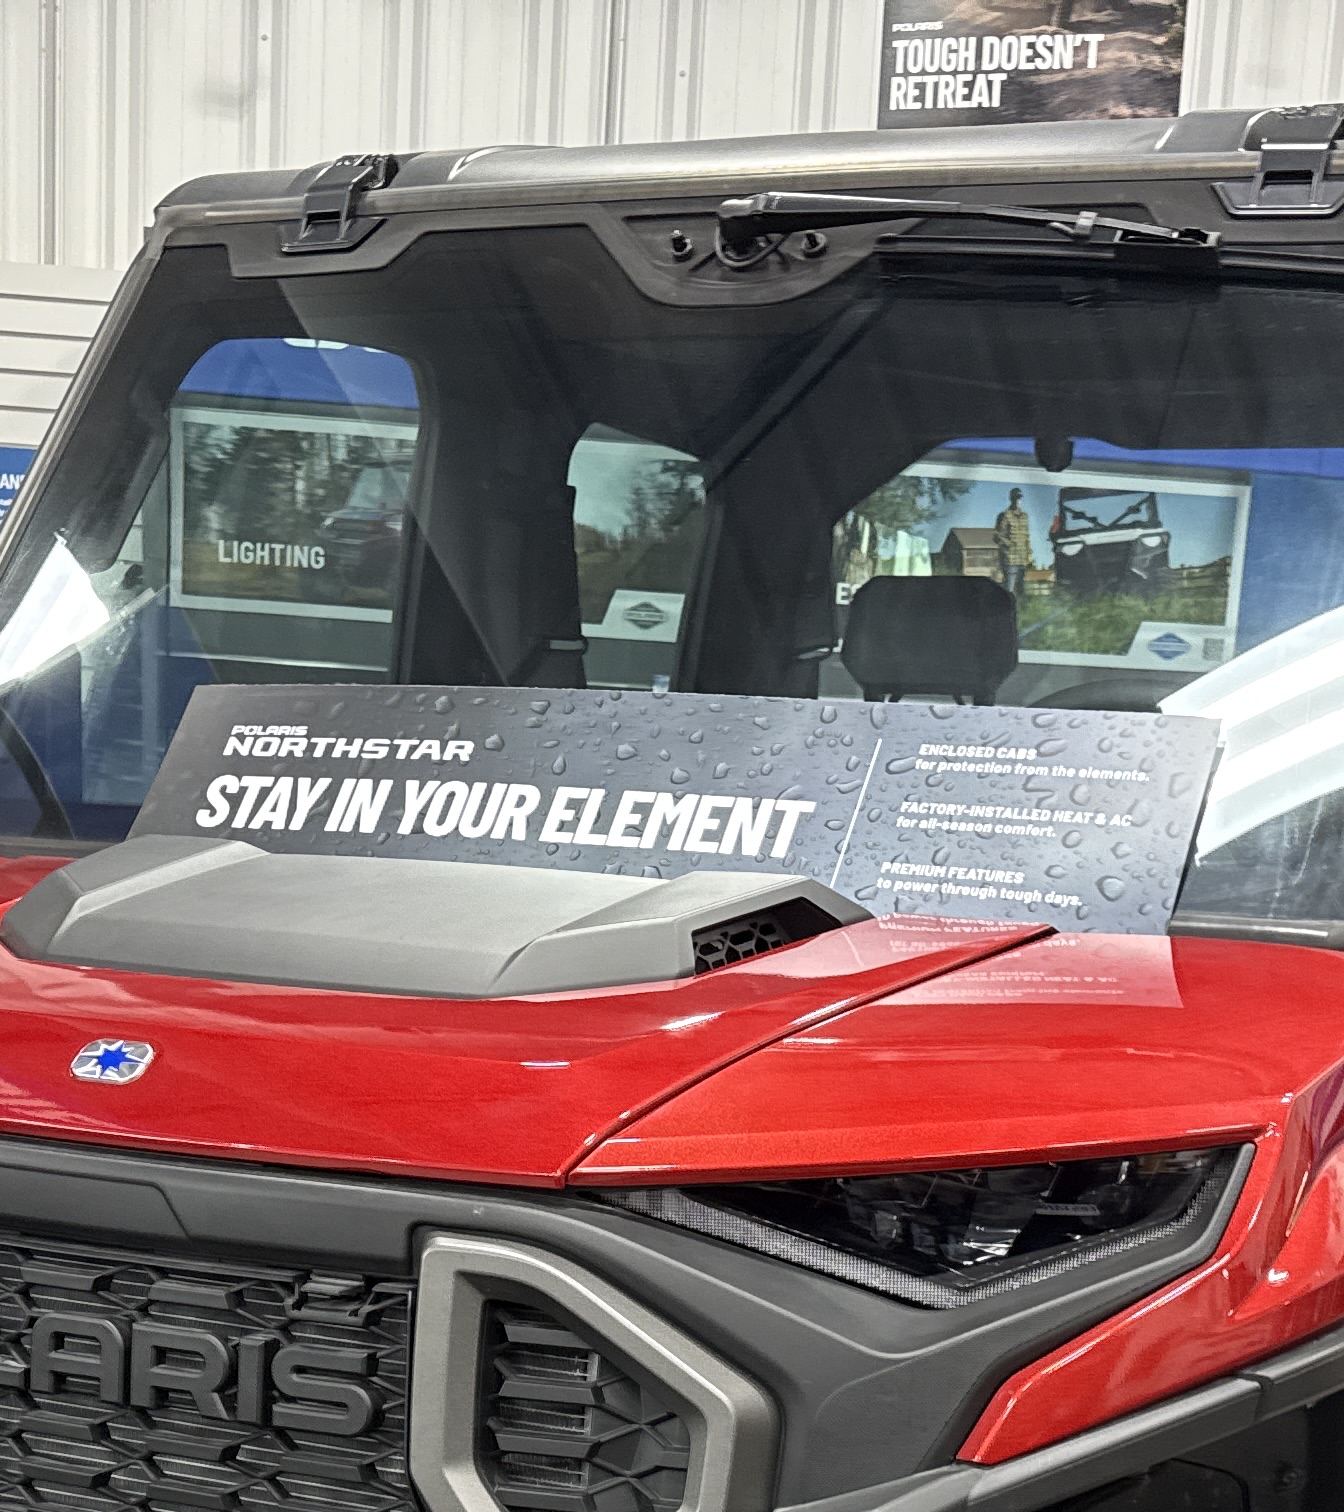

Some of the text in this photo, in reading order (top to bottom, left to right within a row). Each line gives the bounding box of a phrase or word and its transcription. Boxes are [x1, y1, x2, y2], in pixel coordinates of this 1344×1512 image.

[892, 33, 1106, 74] TOUGH DOESN'T
[889, 73, 1007, 111] RETREAT
[217, 539, 326, 570] LIGHTING
[231, 725, 308, 736] POLARIS
[223, 736, 476, 762] NORTHSTAR
[918, 743, 1038, 760] ENCLOSED CABS
[915, 759, 1150, 782] for protection from the elements.
[195, 774, 817, 858] STAY IN YOUR ELEMENT
[896, 816, 1057, 838] for all-season comfort.
[900, 801, 1133, 827] FACTORY-INSTALLED HEAT & AC
[880, 862, 1025, 885] PREMIUM FEATURES
[876, 877, 1083, 907] to power through tough days.
